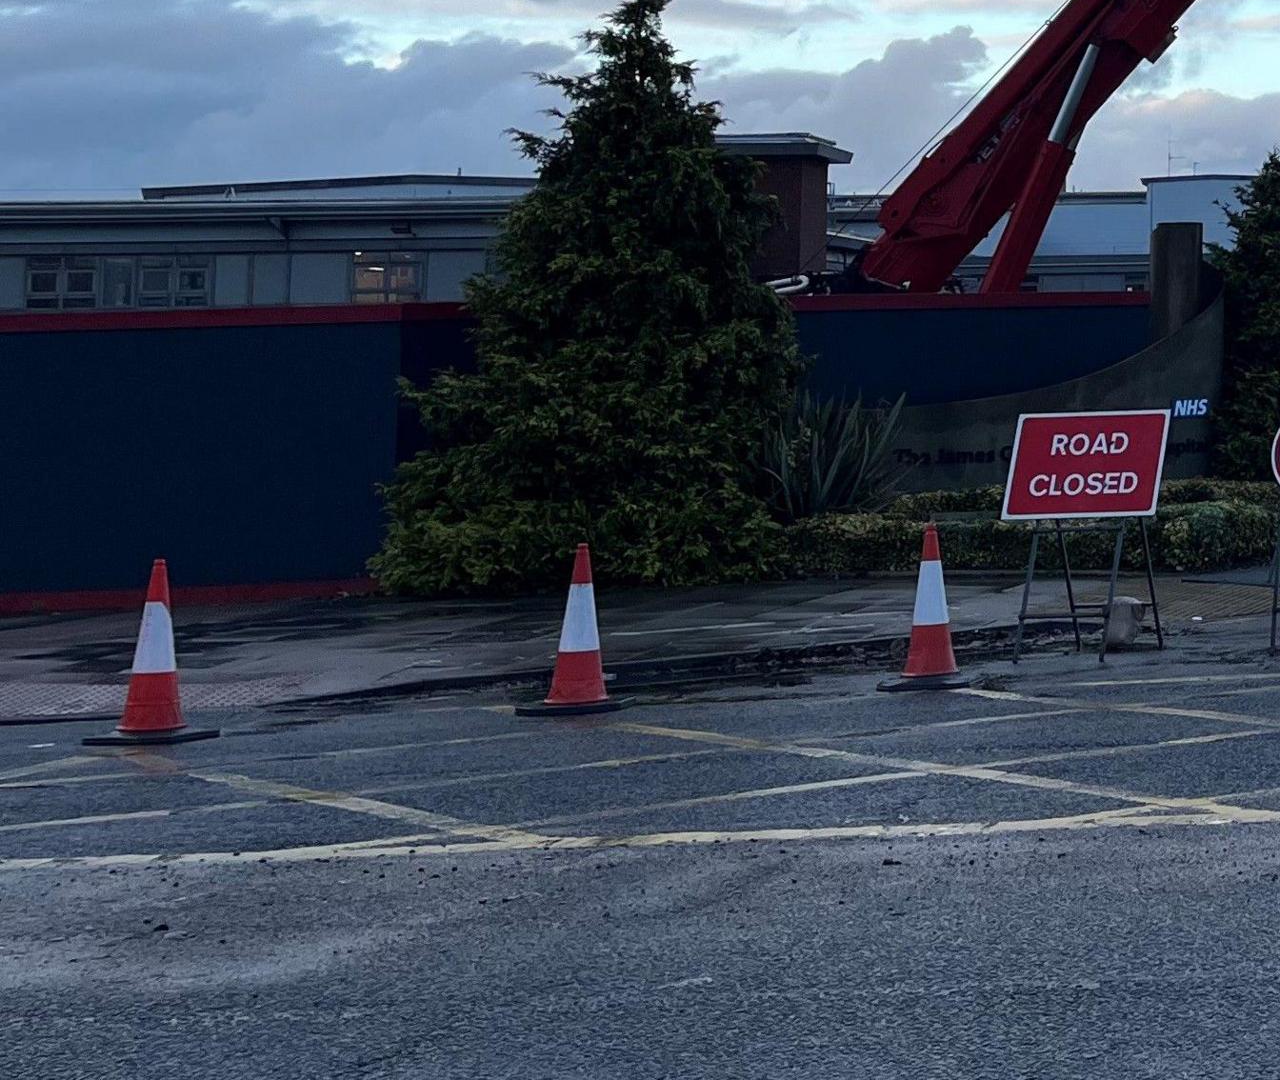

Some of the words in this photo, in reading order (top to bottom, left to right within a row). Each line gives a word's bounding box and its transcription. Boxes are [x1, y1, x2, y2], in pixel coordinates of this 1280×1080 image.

[1173, 399, 1208, 418] NHS
[1050, 432, 1129, 456] ROAD
[1029, 471, 1138, 497] CLOSED
